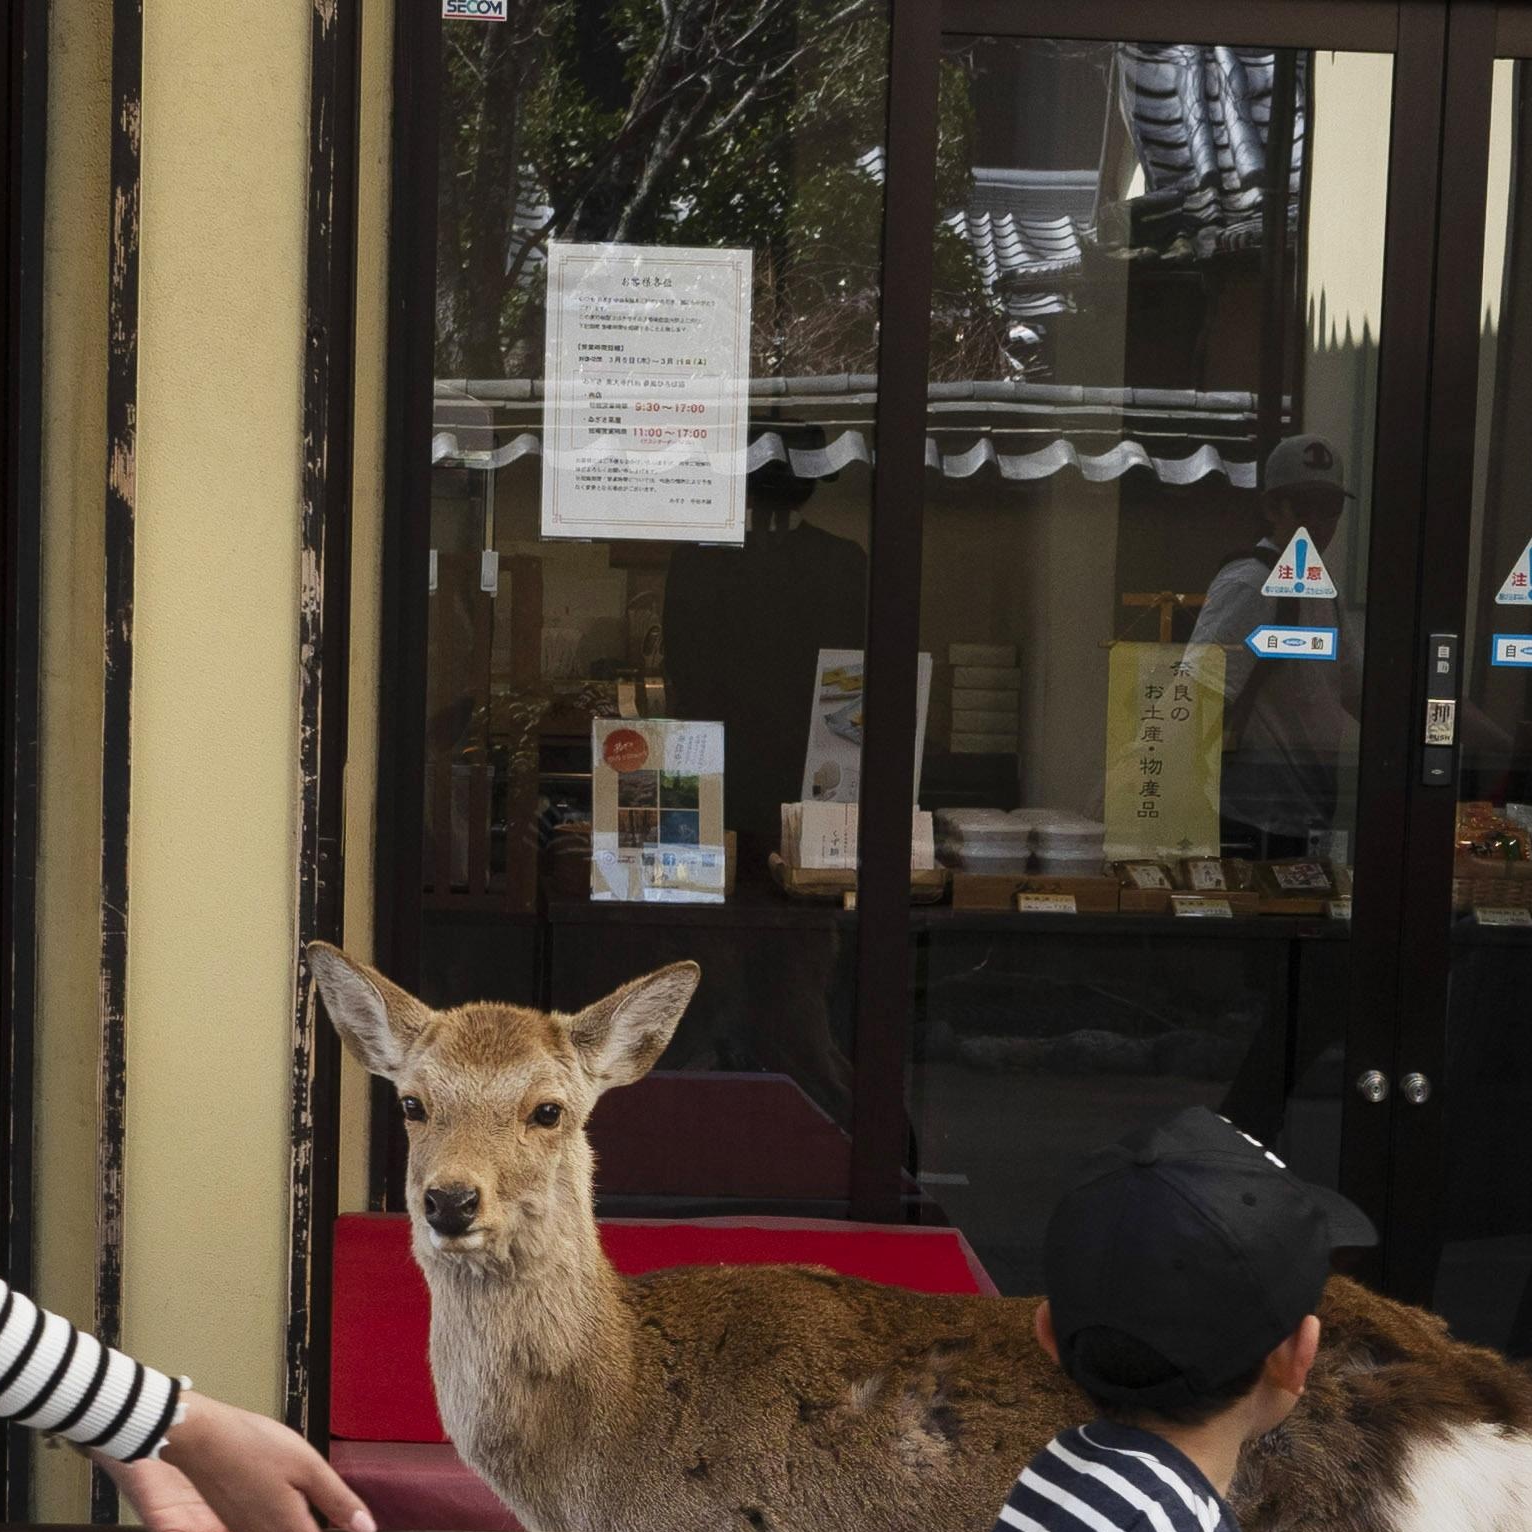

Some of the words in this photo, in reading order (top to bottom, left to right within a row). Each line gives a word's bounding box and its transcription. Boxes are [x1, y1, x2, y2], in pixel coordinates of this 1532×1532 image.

[446, 0, 502, 15] SECOM
[633, 427, 709, 439] 11:00～17:00
[1170, 660, 1193, 722] 奈良の
[1137, 684, 1164, 819] お土産・物産品
